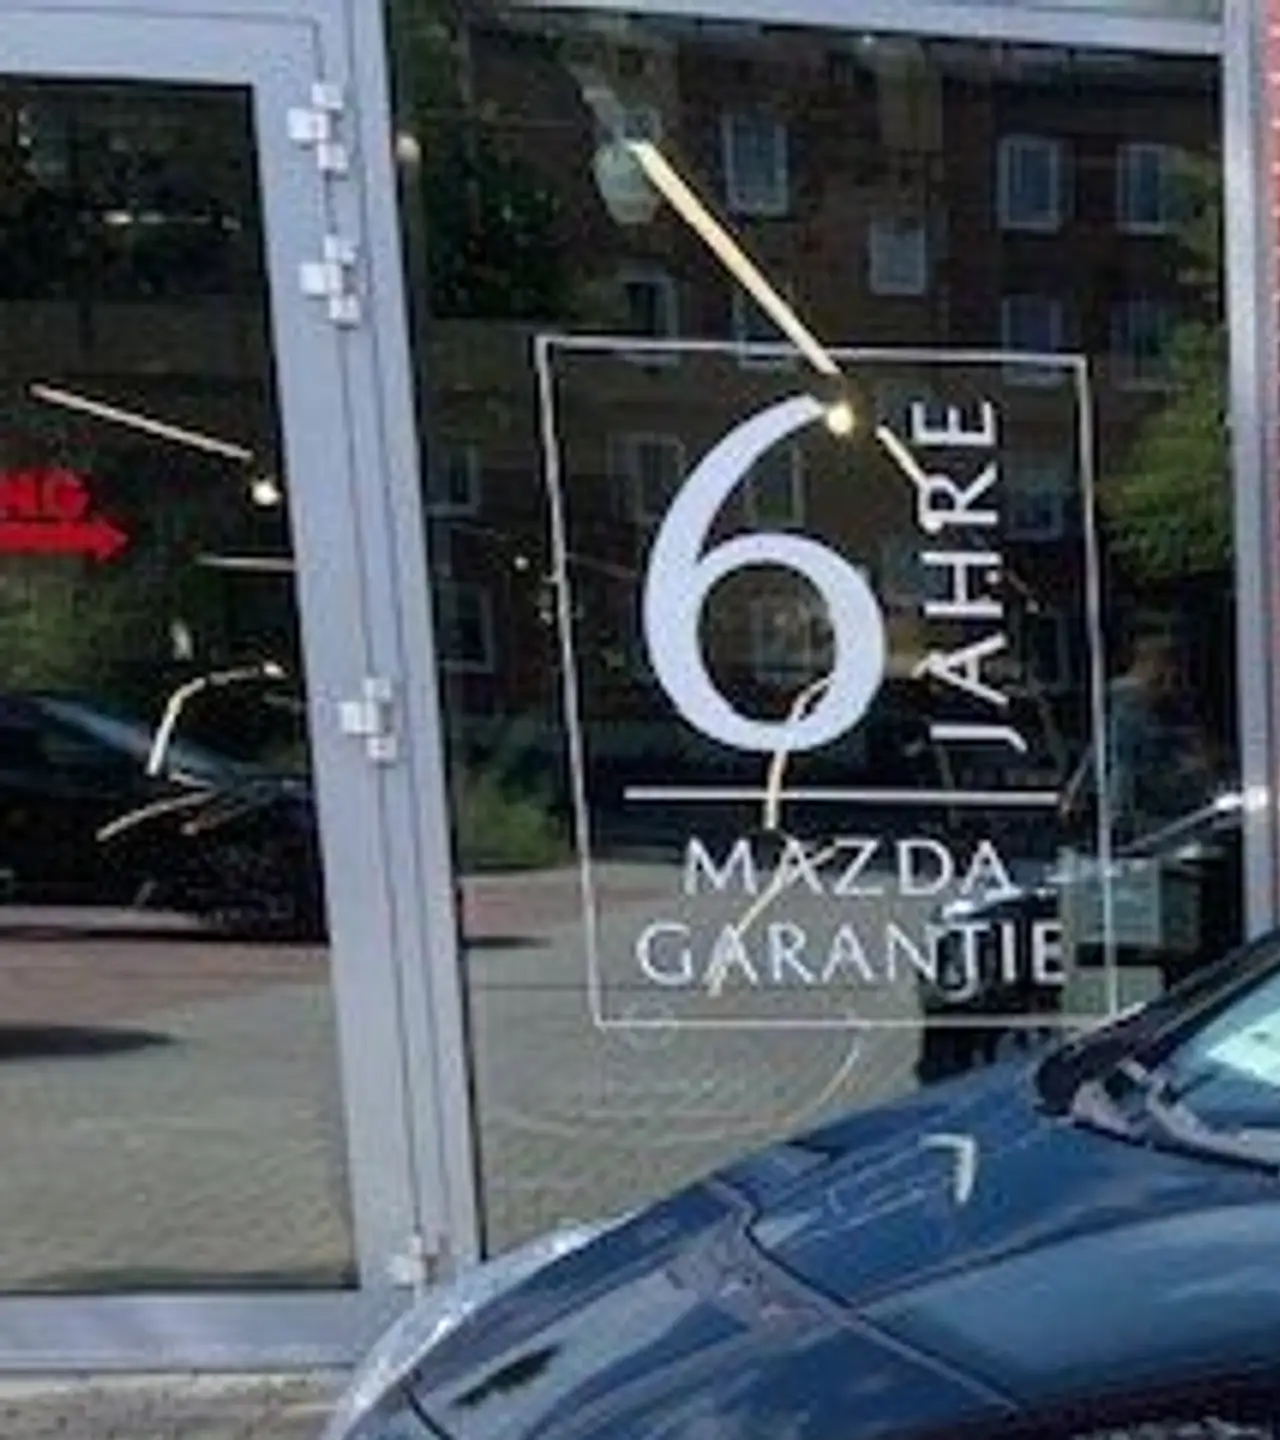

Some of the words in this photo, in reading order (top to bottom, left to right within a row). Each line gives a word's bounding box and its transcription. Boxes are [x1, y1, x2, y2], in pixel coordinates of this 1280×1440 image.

[643, 396, 885, 751] 6
[912, 402, 1027, 752] JAHRE
[636, 922, 1067, 986] GARANTIE
[682, 838, 1012, 896] MAZDA
